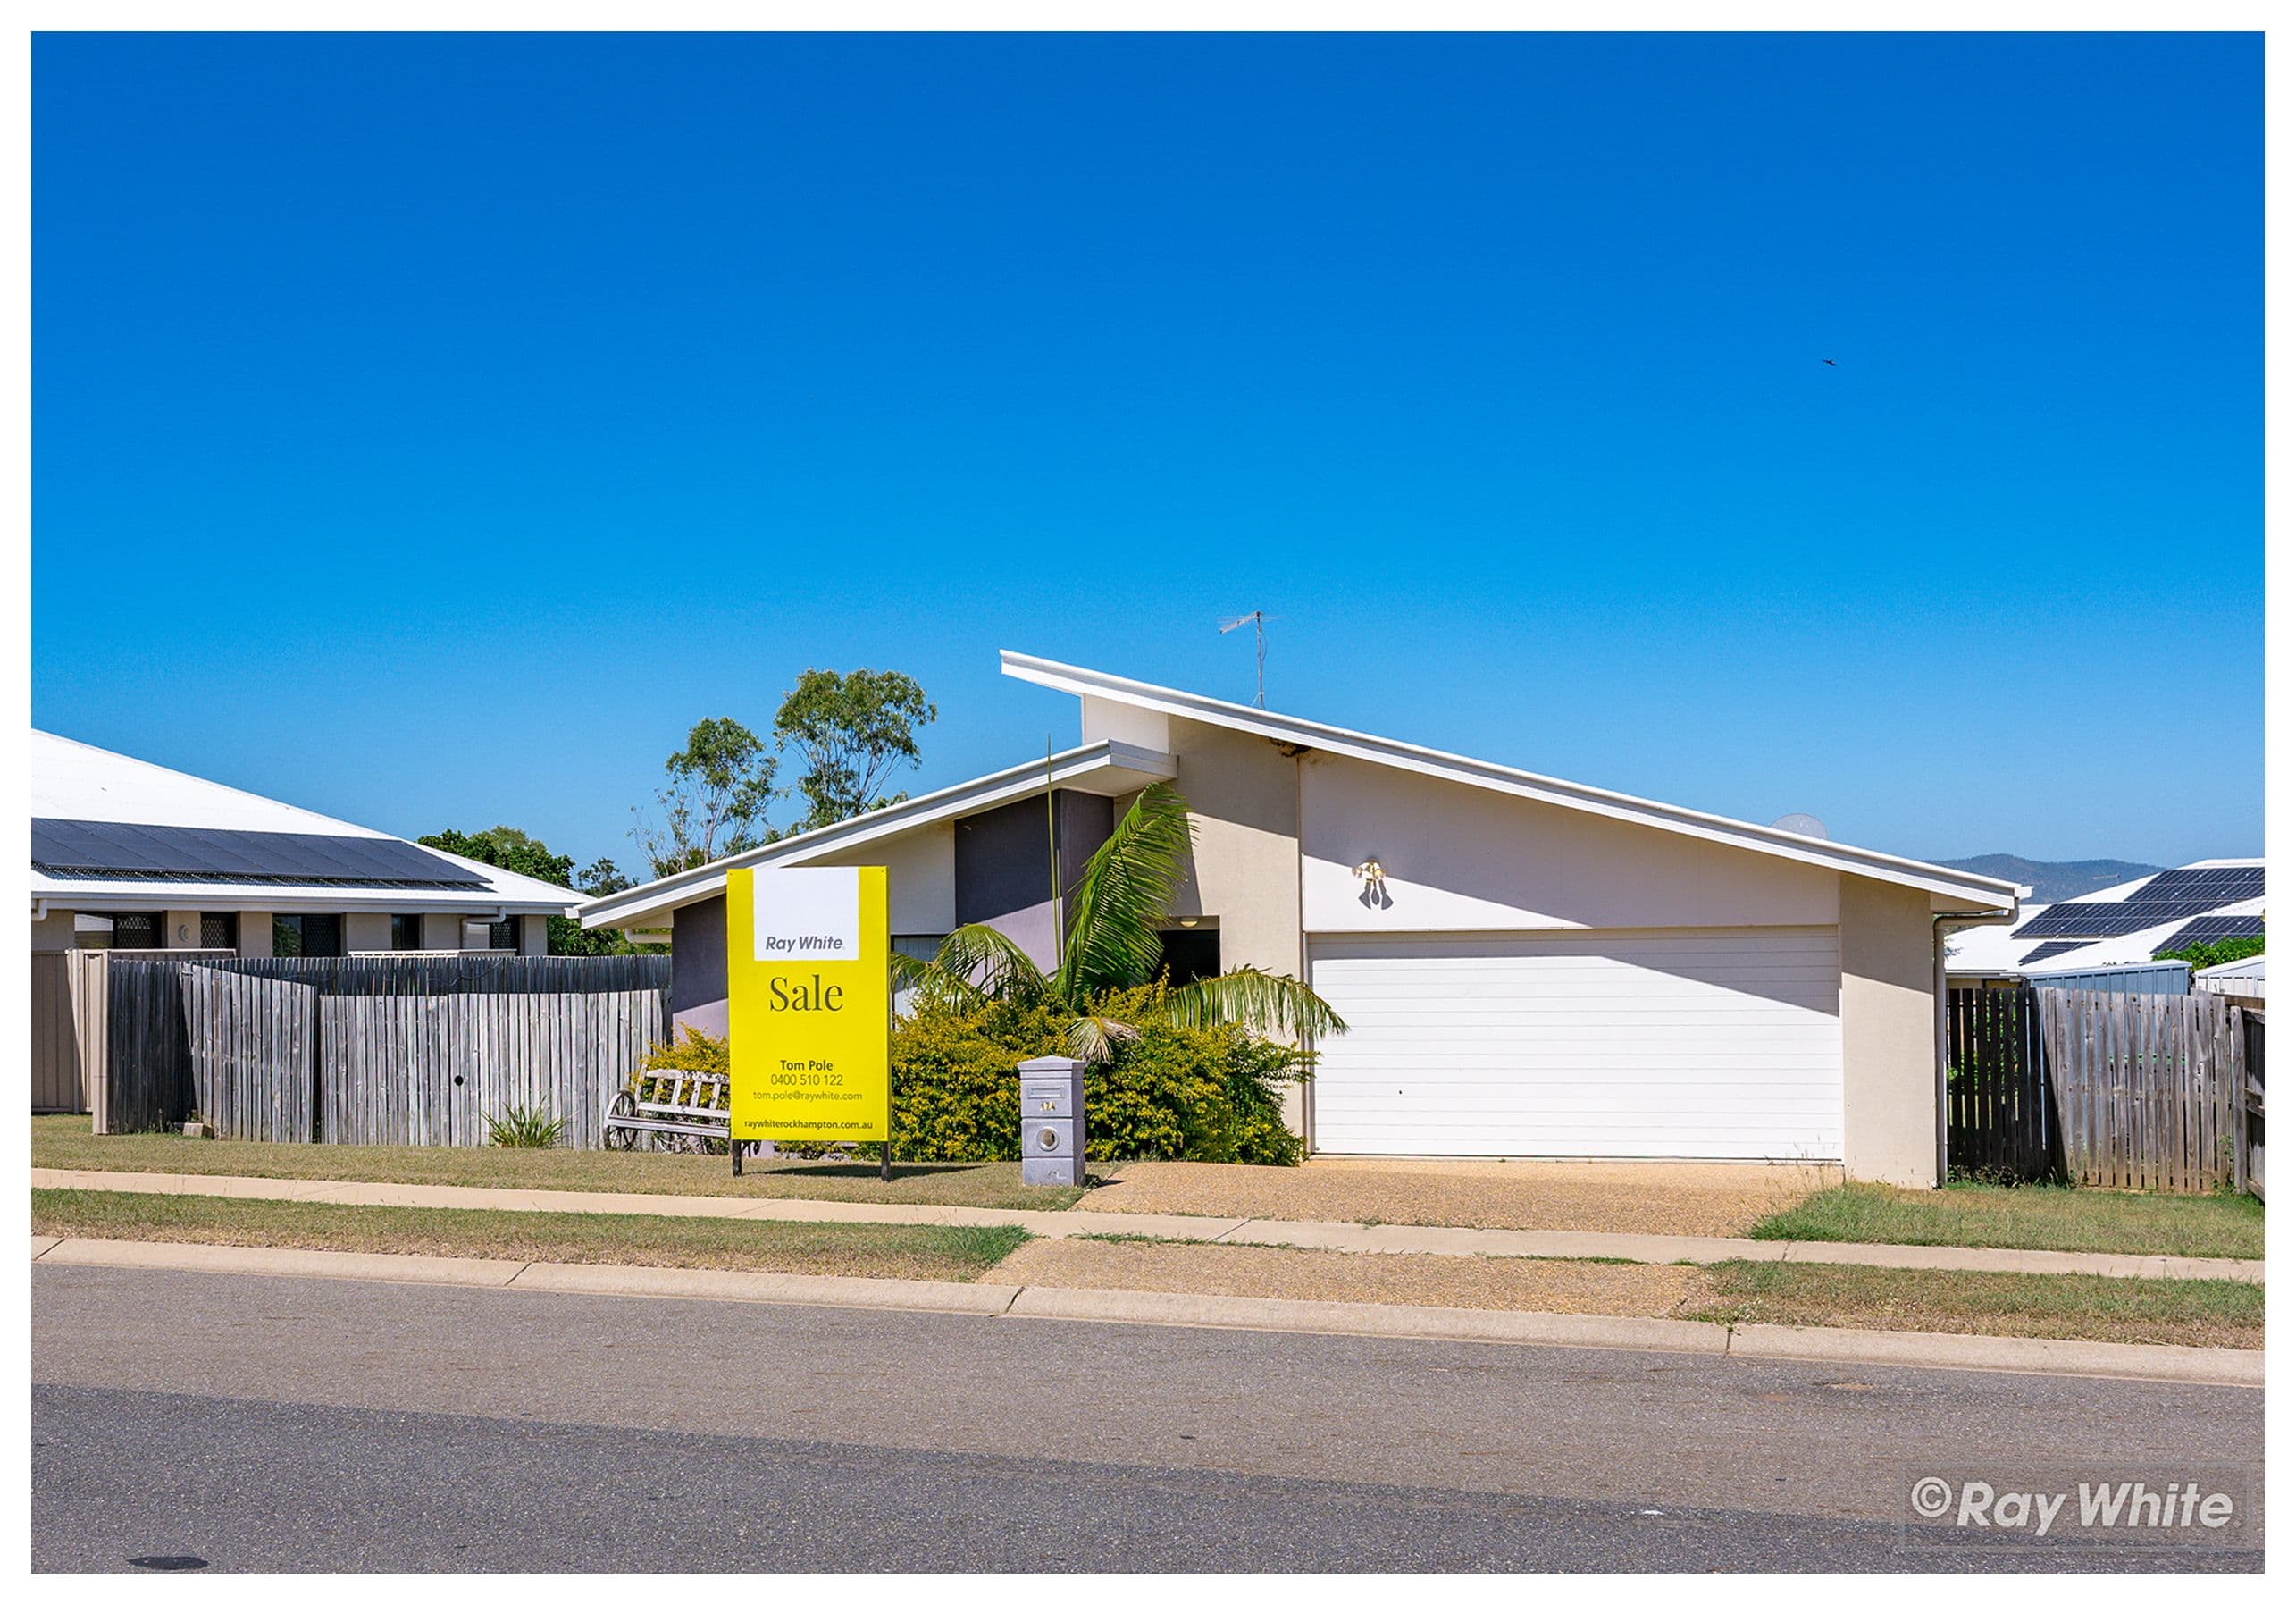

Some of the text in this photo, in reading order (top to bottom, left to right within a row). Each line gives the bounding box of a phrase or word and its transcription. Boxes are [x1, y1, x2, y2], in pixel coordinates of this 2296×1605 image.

[766, 936, 843, 953] Ray White
[769, 974, 844, 1012] Sale
[780, 1060, 834, 1071] Tom Pole
[771, 1074, 843, 1086] 0400 510 122
[753, 1090, 863, 1102] tom.pole@raywhite.com
[744, 1120, 873, 1130] raywhiterockhampton.com.au
